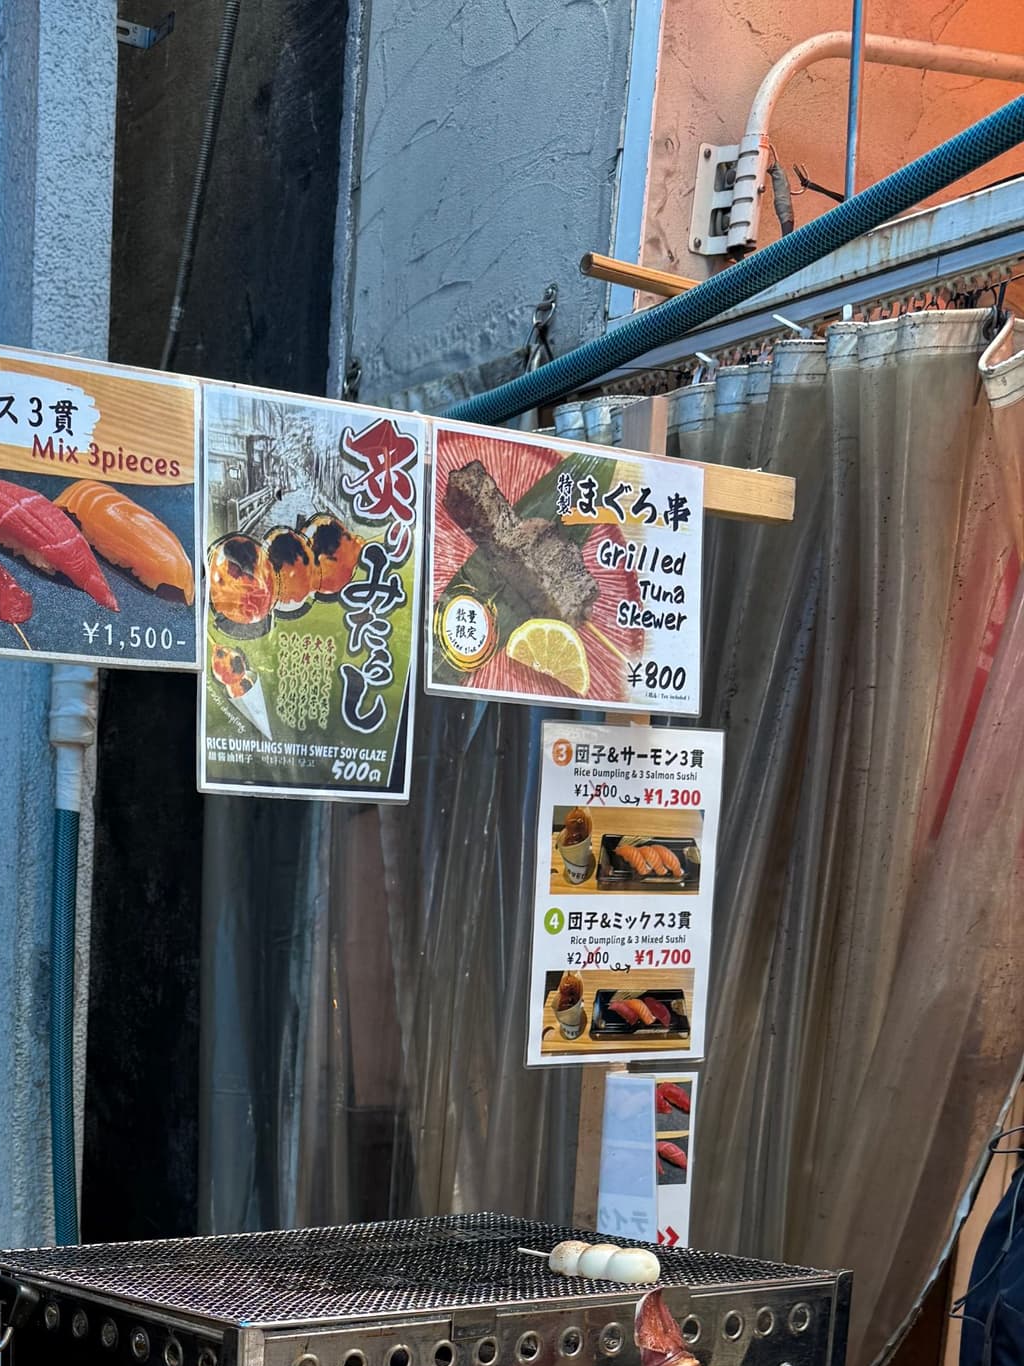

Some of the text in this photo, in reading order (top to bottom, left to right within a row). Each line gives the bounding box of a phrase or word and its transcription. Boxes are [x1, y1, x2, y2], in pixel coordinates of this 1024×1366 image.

[32, 434, 181, 477] Mix 3pieces
[556, 473, 574, 516] 特製
[578, 477, 690, 531] まぐろ串
[599, 541, 686, 576] Grilled
[618, 601, 687, 632] Skewer
[82, 622, 186, 650] ¥1,500-
[456, 625, 477, 641] 限定
[627, 661, 686, 691] ¥800
[206, 737, 387, 762] RICE DUMPLINGS WITH SWEET SOY GLAZE
[574, 744, 704, 769] 団子&サーモン3貫
[574, 768, 698, 781] Rice Dumpling & 3 Salmon Sushi
[644, 787, 701, 806] ¥1,300
[568, 911, 691, 931] 団子&ミックス3貫
[570, 934, 686, 946] Rice Dumpling & 3 Mixed Sushi
[635, 949, 691, 966] ¥1,700
